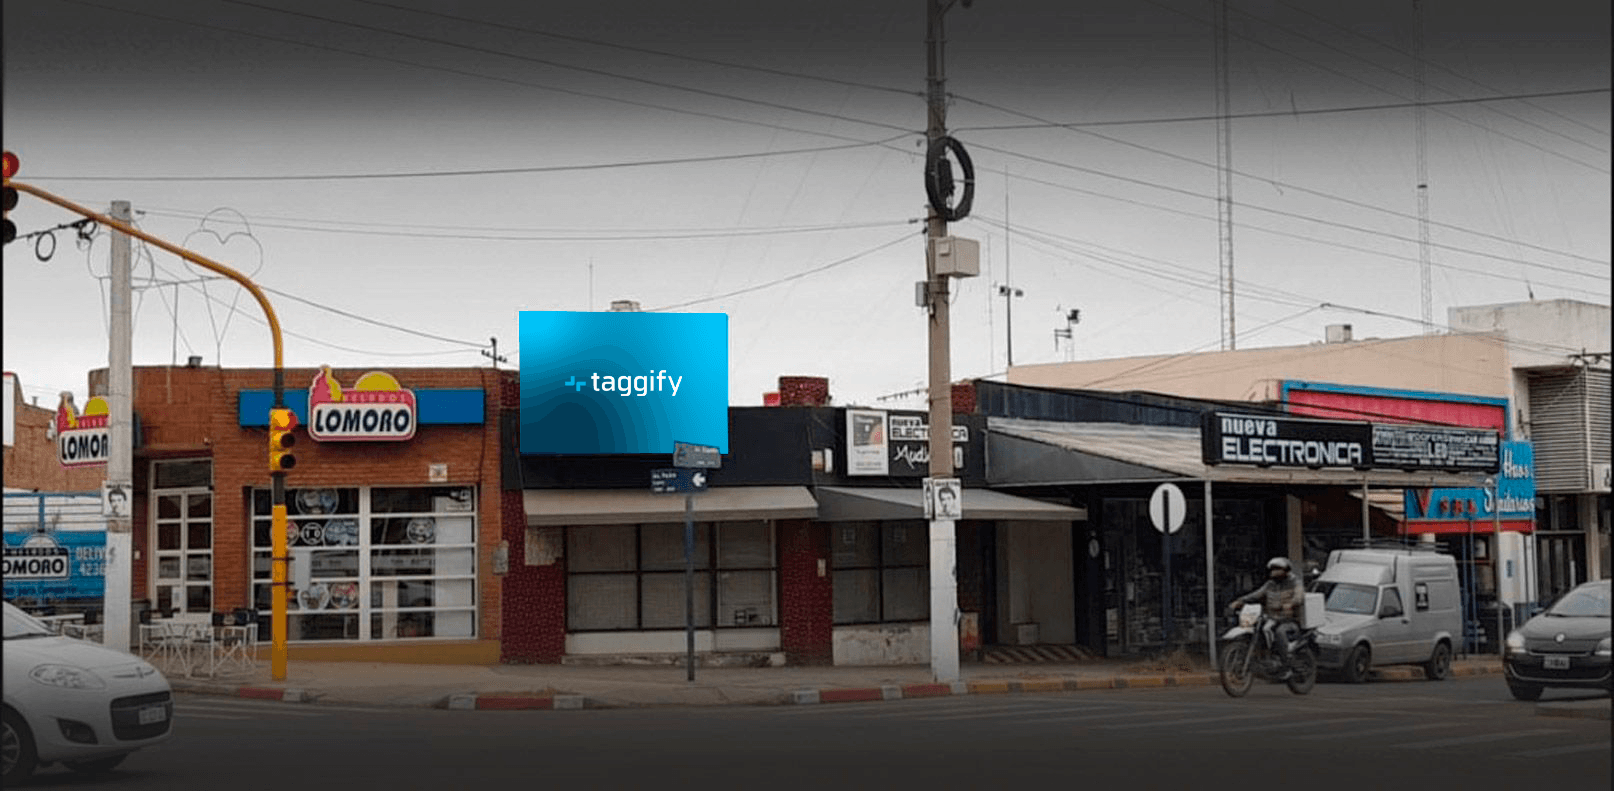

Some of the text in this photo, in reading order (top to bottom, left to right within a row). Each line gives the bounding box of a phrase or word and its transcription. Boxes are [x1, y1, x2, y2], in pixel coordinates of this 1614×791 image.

[591, 370, 682, 396] taggify
[315, 409, 409, 432] LOMORO
[1222, 418, 1277, 436] nueva
[61, 434, 108, 460] LOMOR
[1222, 436, 1362, 464] ELECTRONICA
[2, 559, 64, 575] OMORO
